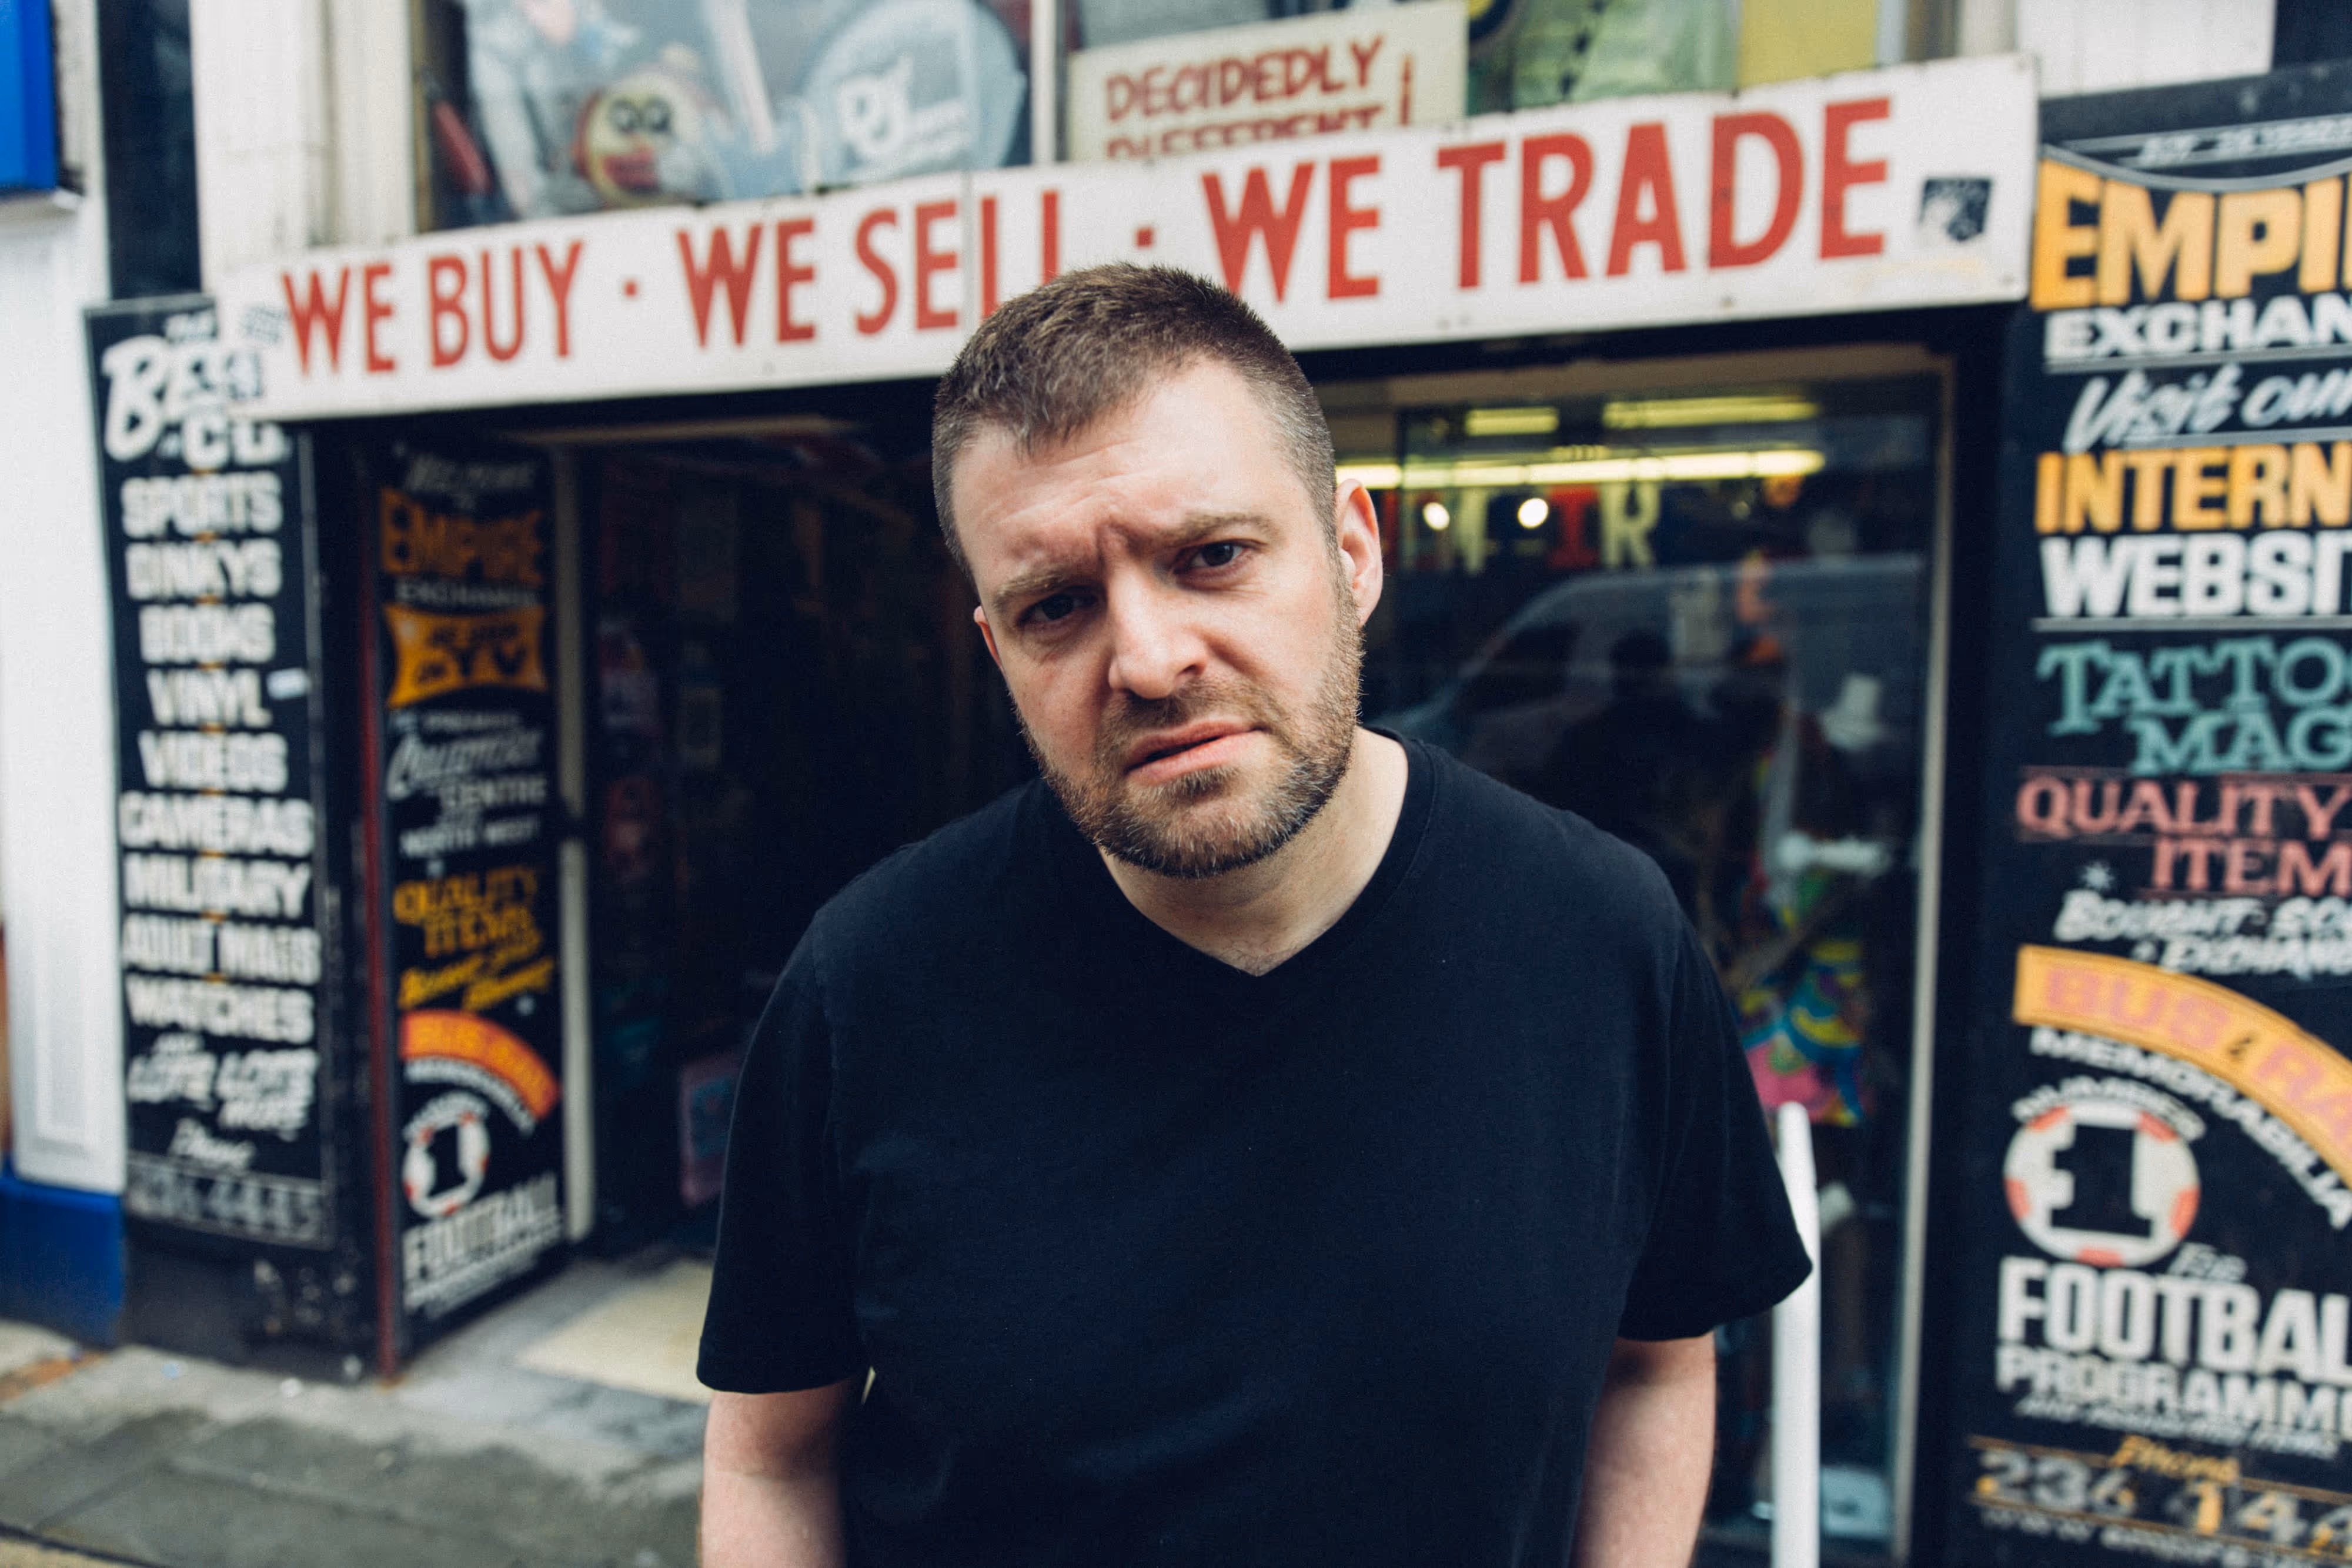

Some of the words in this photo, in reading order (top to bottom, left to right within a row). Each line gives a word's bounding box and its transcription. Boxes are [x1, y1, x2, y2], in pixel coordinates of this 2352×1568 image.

[1106, 36, 1384, 121] DECIDEDLY
[283, 264, 395, 376] WE
[428, 240, 582, 367] BUY
[676, 218, 815, 346] WE
[1201, 156, 1381, 303] WE
[1438, 97, 1890, 289] TRADE
[2029, 158, 2352, 311] EMPI
[2062, 362, 2243, 454] Visit
[121, 473, 283, 537] SPORTS
[2039, 530, 2352, 617] WEBSI
[139, 603, 275, 663] BOOKS
[146, 668, 272, 728] VINYL
[2036, 636, 2352, 735] TATTO
[138, 730, 288, 794] VIDEOS
[118, 791, 316, 857] CAMERAS
[2017, 777, 2351, 840] QUALITY
[123, 852, 312, 919] MILITARY
[2151, 838, 2352, 895] ITEM
[125, 974, 315, 1044] WATCHES
[2045, 966, 2233, 1049] BUS
[1996, 1343, 2352, 1444] PROGRAMM
